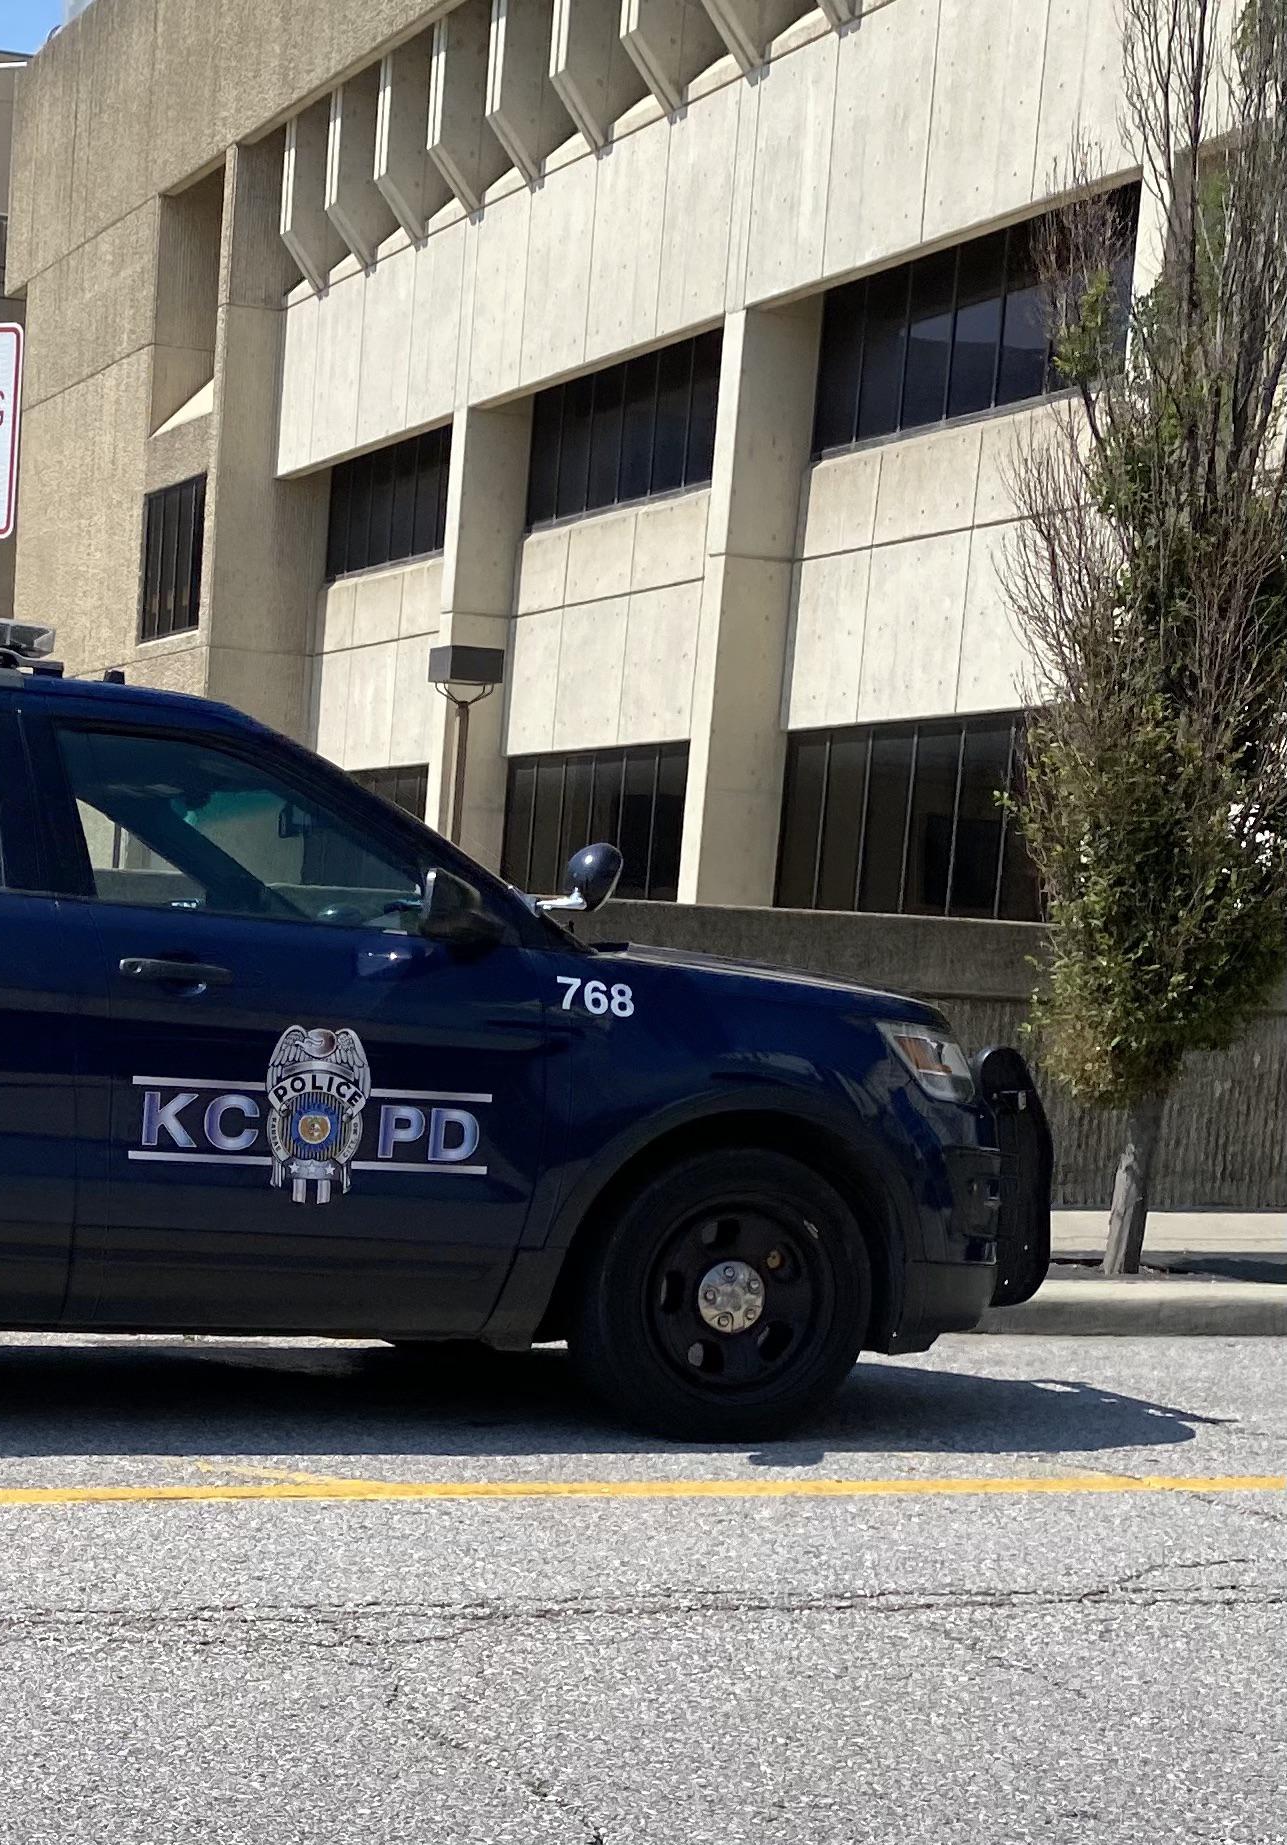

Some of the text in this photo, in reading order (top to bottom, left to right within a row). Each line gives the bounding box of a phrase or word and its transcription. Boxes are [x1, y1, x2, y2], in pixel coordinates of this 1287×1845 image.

[556, 975, 635, 1018] 768
[273, 1074, 362, 1107] POLICE
[142, 1091, 260, 1151] KC
[377, 1105, 480, 1162] PD
